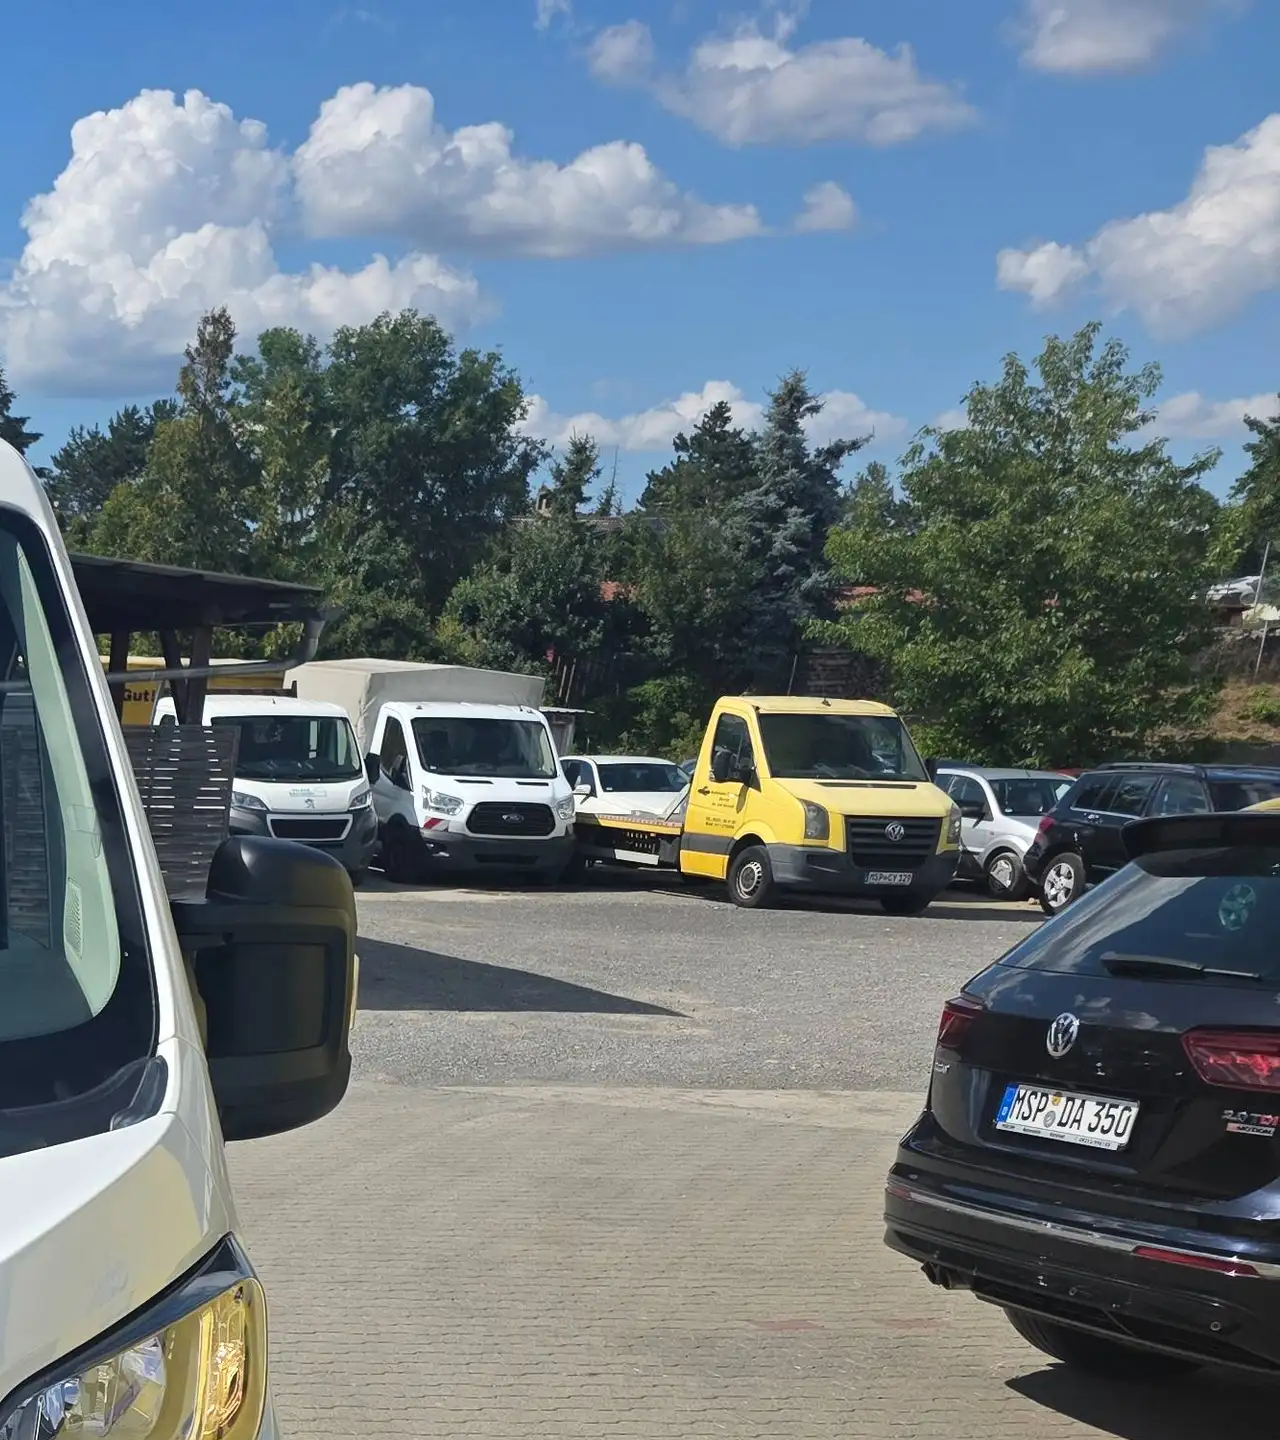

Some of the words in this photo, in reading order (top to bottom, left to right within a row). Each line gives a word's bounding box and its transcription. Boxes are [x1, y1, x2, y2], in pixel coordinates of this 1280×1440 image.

[1009, 1088, 1050, 1122] MSP
[1057, 1096, 1086, 1131] DA
[1087, 1101, 1132, 1138] 350
